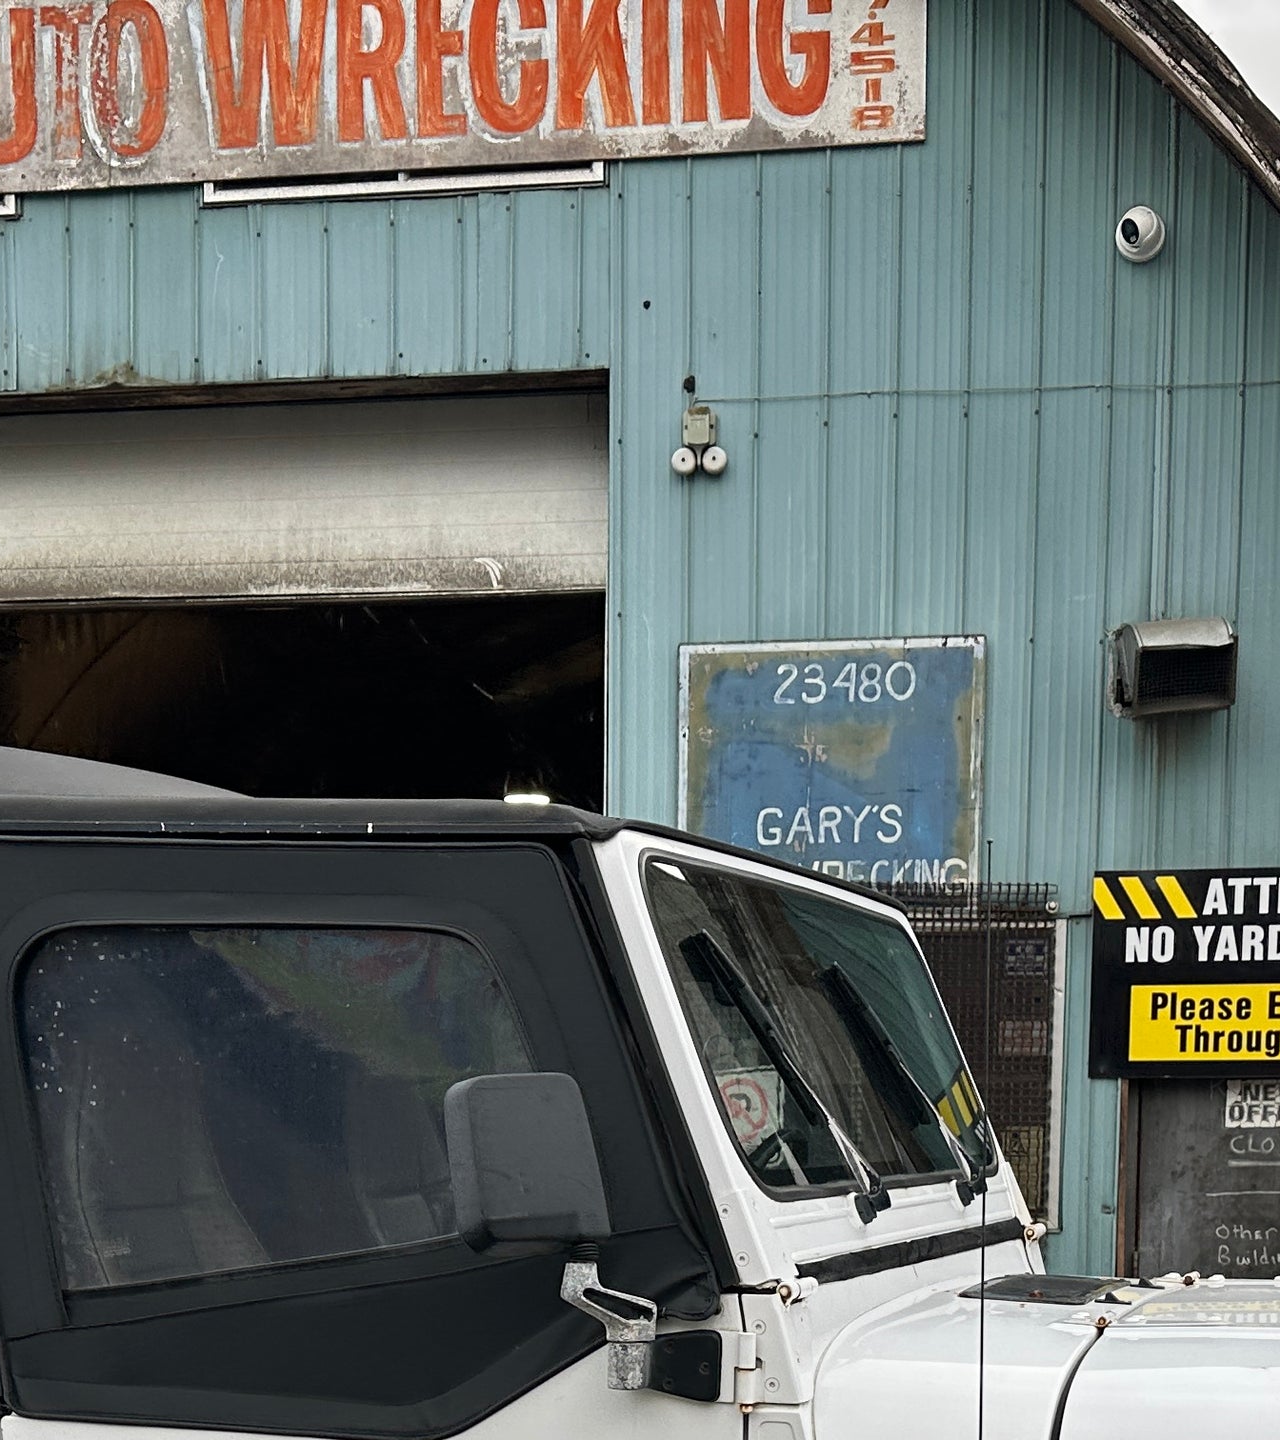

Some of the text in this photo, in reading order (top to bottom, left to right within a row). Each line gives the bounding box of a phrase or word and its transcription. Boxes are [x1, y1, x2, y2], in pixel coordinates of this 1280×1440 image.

[201, 0, 832, 149] WRECKING
[772, 660, 917, 705] 23480
[756, 803, 904, 847] GARY'S
[1124, 925, 1175, 963] NO
[1150, 991, 1252, 1021] Please
